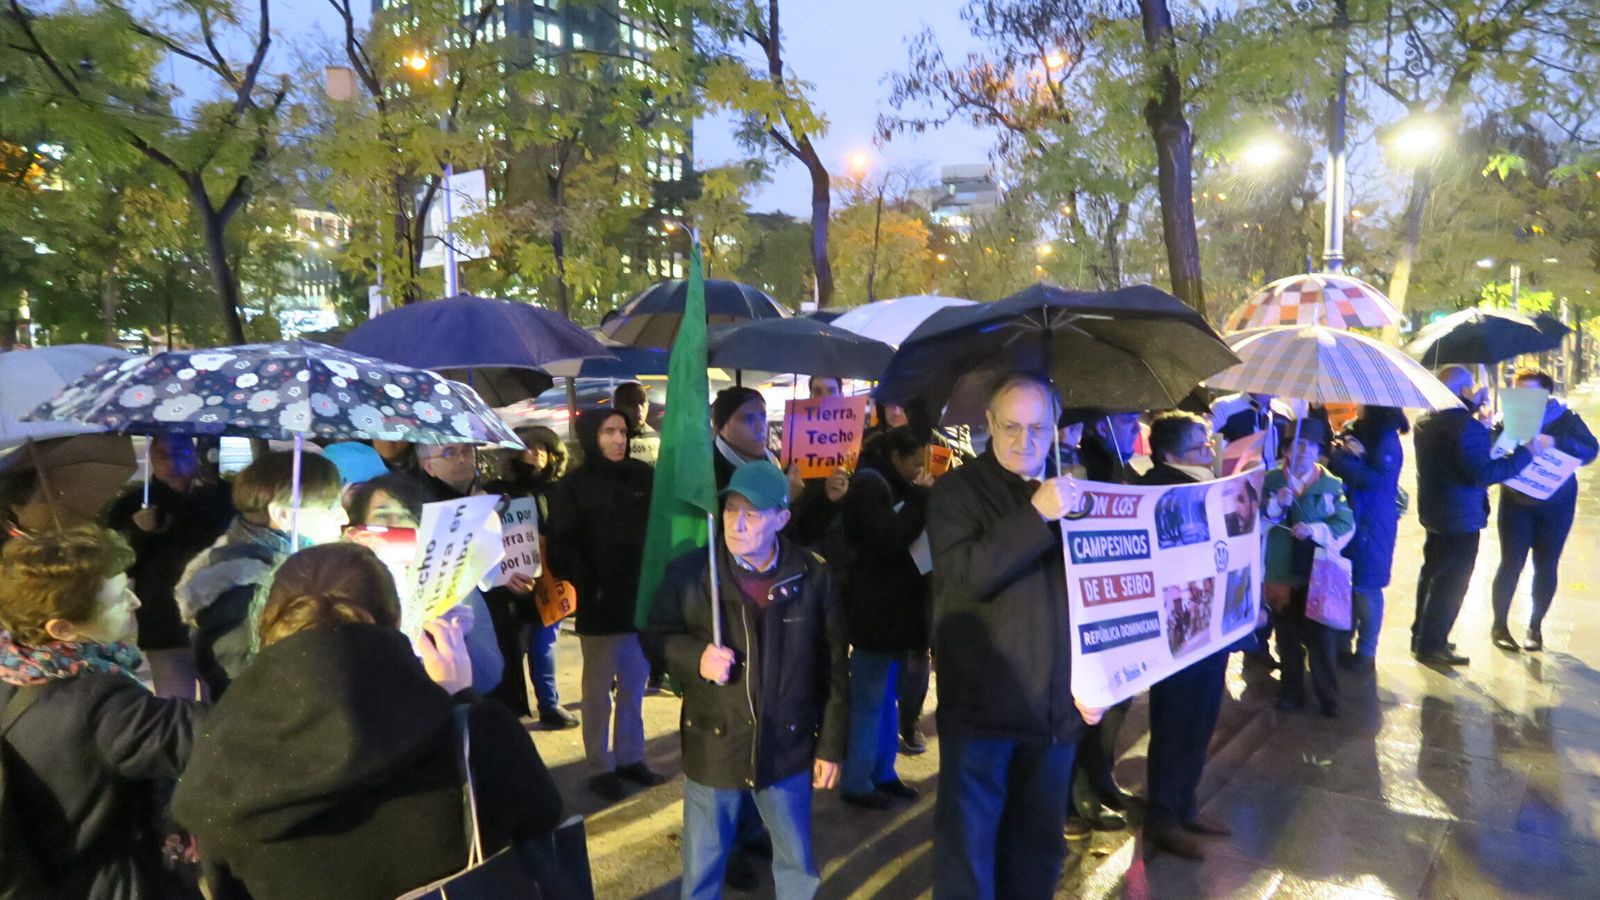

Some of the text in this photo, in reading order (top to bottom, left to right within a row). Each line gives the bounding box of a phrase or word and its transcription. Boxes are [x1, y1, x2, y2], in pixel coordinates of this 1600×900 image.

[805, 407, 856, 421] Tierra,
[806, 429, 853, 445] Techo
[1112, 496, 1137, 516] LOS
[516, 510, 531, 524] por
[1073, 533, 1148, 559] CAMPESINOS
[500, 557, 519, 575] por
[1084, 573, 1151, 601] DE EL SEIBO
[1083, 618, 1160, 647] REPÚBLICA DOMINICANA
